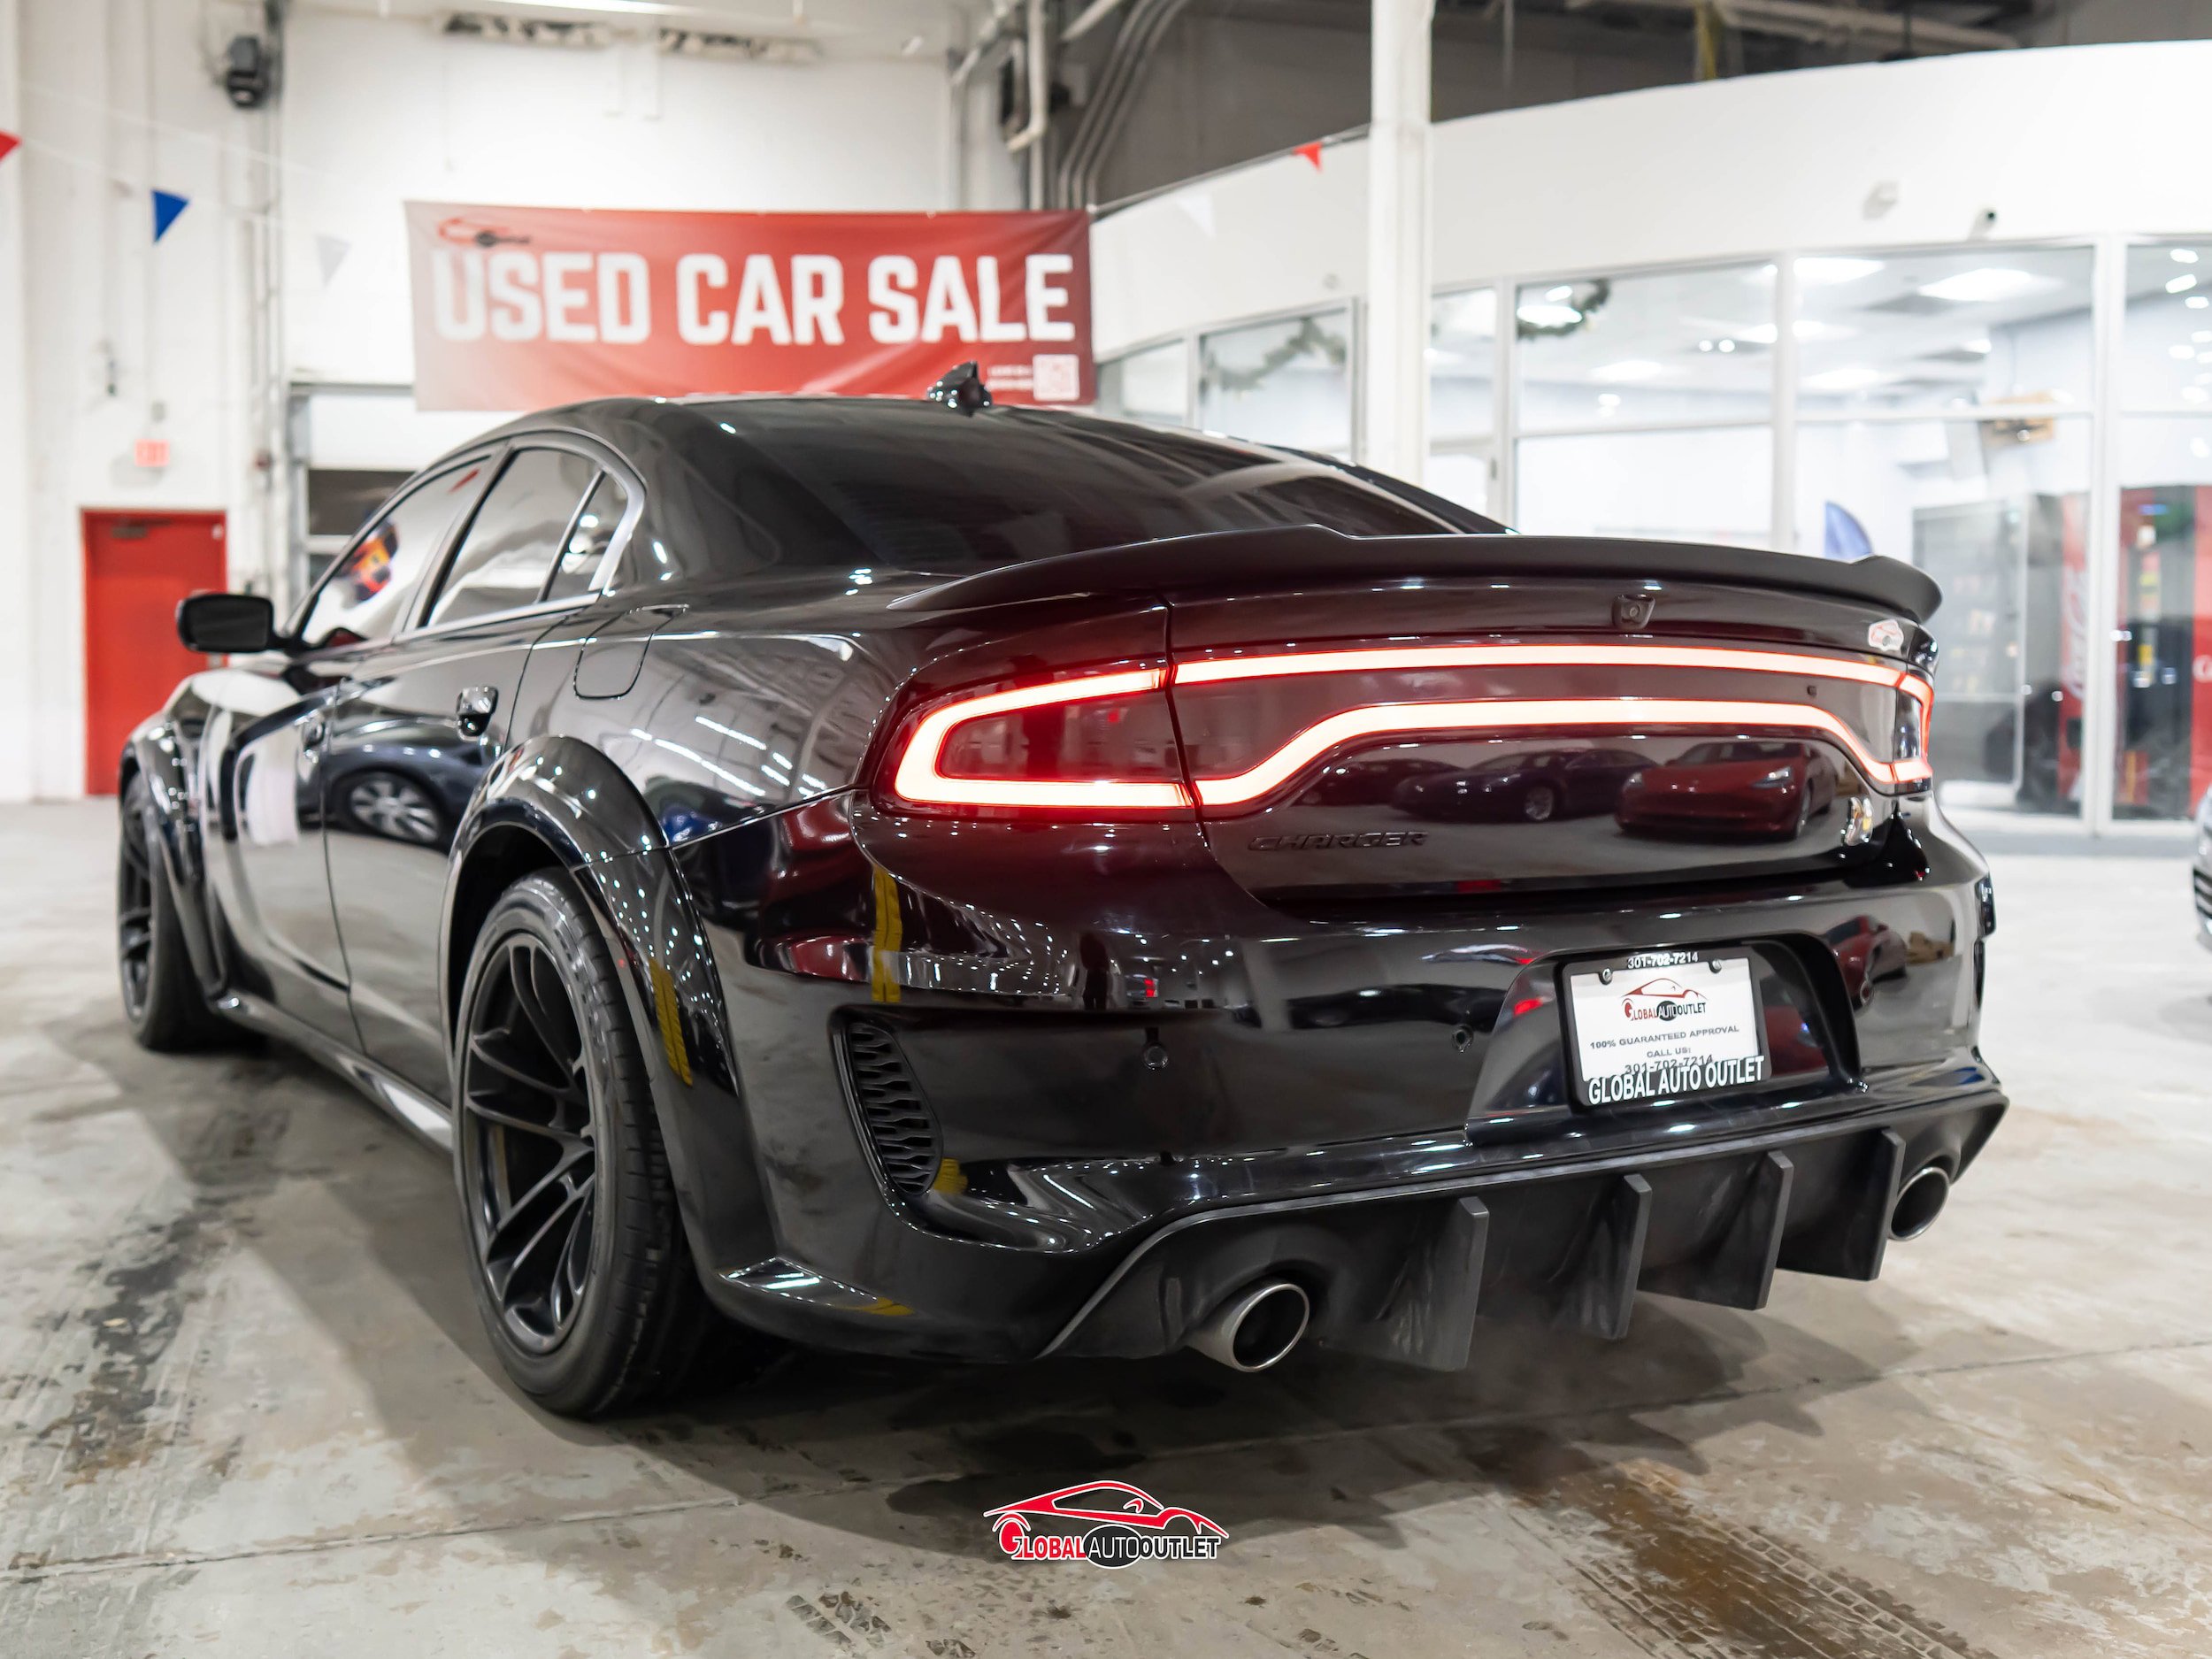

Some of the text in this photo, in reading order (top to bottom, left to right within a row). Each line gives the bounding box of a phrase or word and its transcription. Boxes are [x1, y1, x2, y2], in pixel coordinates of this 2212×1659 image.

[434, 250, 1075, 345] USED CAR SALE
[1248, 832, 1429, 850] CHARGER
[1627, 951, 1699, 970] 301-702-7214
[1590, 1025, 1740, 1049] 100% GUARANTEED APPROVAL
[1647, 1049, 1673, 1058] CALL
[1588, 1055, 1765, 1105] GLOBAL AUTO OUTLET
